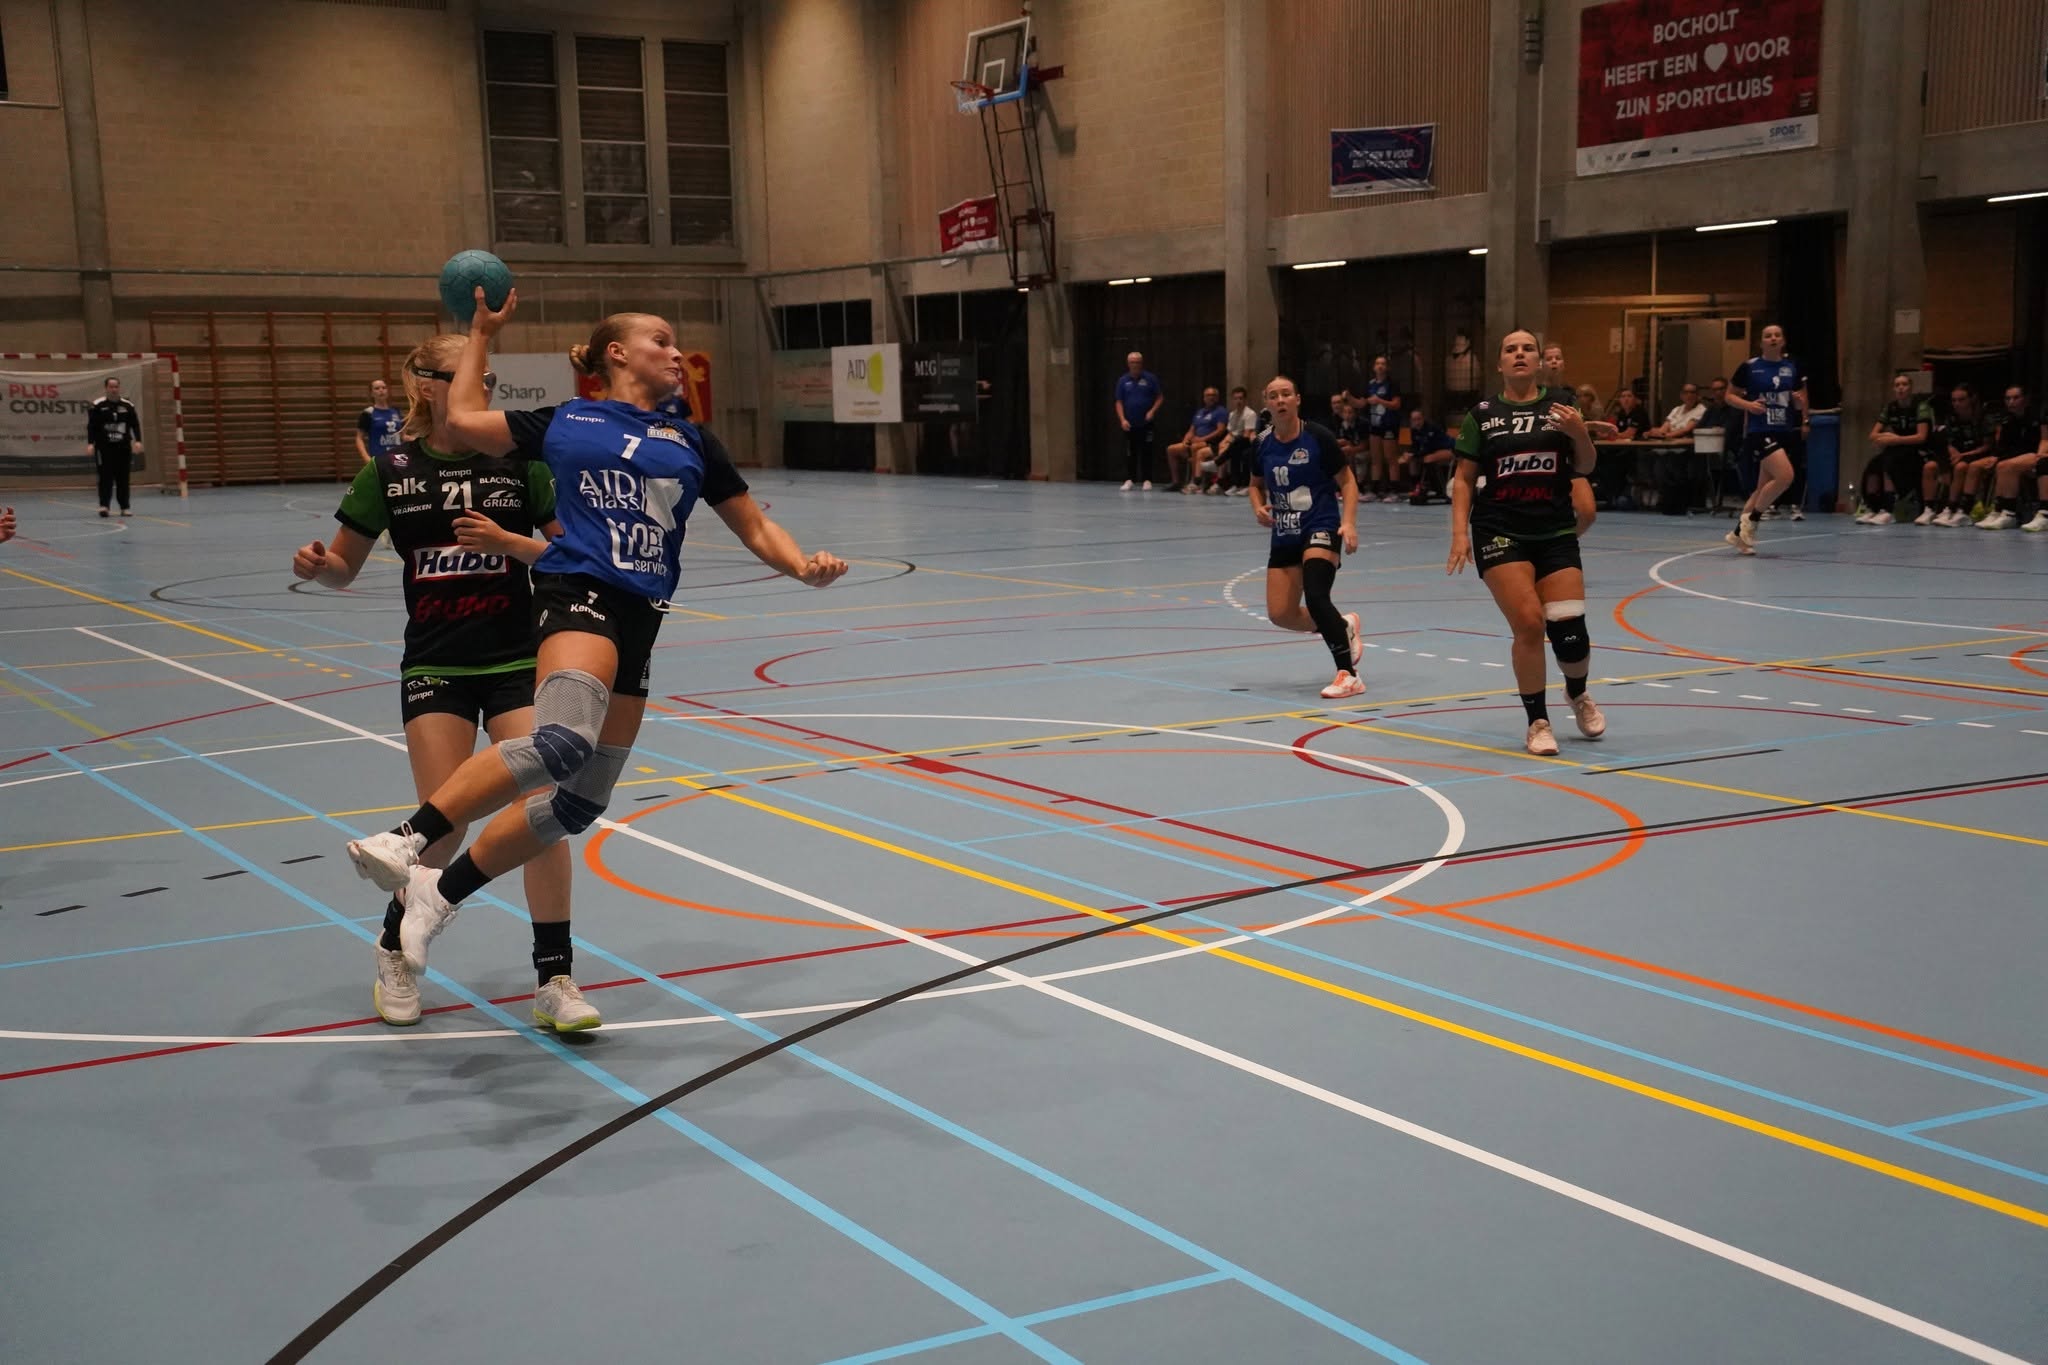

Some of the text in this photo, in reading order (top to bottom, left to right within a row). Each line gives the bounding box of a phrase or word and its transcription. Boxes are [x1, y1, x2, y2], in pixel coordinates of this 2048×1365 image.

[1653, 8, 1739, 44] BOCHOLT
[1604, 36, 1791, 88] HEEFT EEN VOOR
[1616, 97, 1650, 120] ZIJN
[1656, 76, 1774, 113] SPORTCLUBS
[1769, 123, 1802, 138] SPORT
[848, 359, 867, 380] AID
[9, 384, 58, 398] PLUS
[499, 384, 546, 402] Sharp
[566, 413, 605, 424] Kempa
[1481, 416, 1506, 431] alk
[1512, 416, 1535, 434] 27
[620, 434, 642, 459] 7
[439, 469, 472, 478] Kempa
[1500, 455, 1554, 475] Hubo
[580, 469, 637, 499] AID
[1272, 465, 1290, 487] 18
[387, 477, 427, 498] alk
[441, 480, 473, 510] 21
[582, 489, 641, 511] Glass
[417, 551, 504, 575] Hubo
[588, 590, 599, 605] 7
[570, 603, 606, 621] Kempa
[408, 690, 434, 703] Kempa
